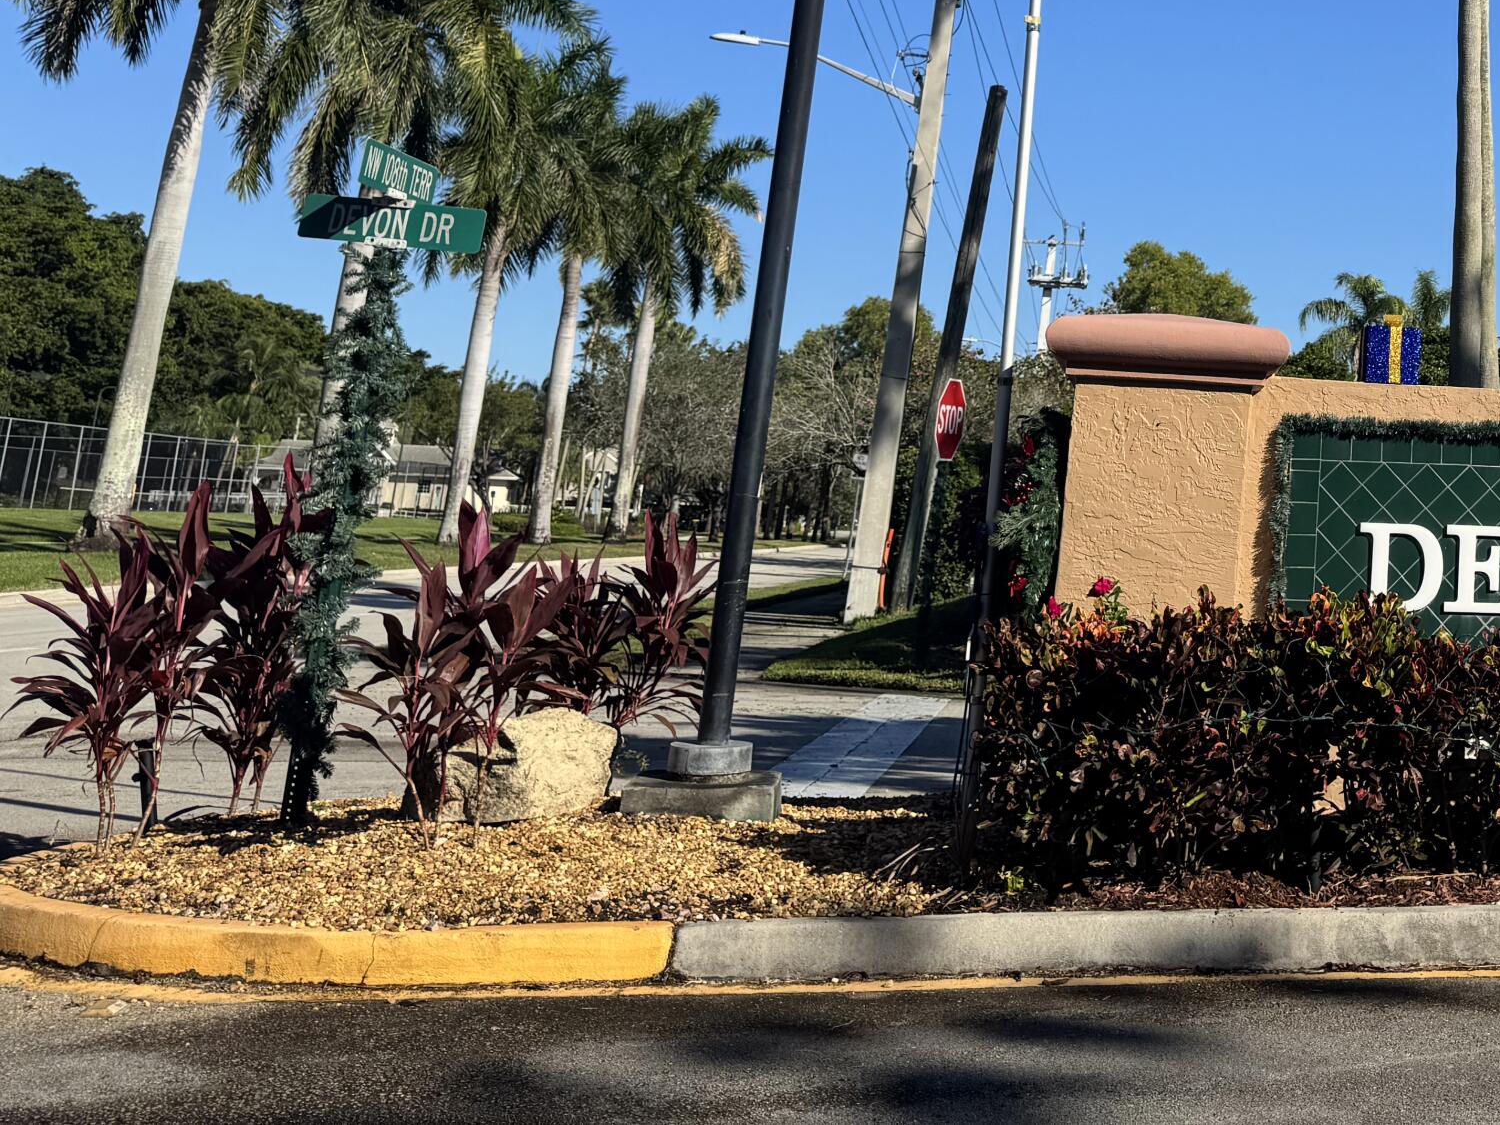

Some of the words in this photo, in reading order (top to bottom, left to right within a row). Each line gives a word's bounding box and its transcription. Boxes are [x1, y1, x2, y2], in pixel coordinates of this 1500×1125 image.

[364, 145, 384, 181] NW
[381, 153, 409, 192] 108th
[408, 164, 433, 203] TERR
[327, 202, 411, 240] DEVON
[419, 211, 455, 245] DR
[937, 404, 964, 435] STOP
